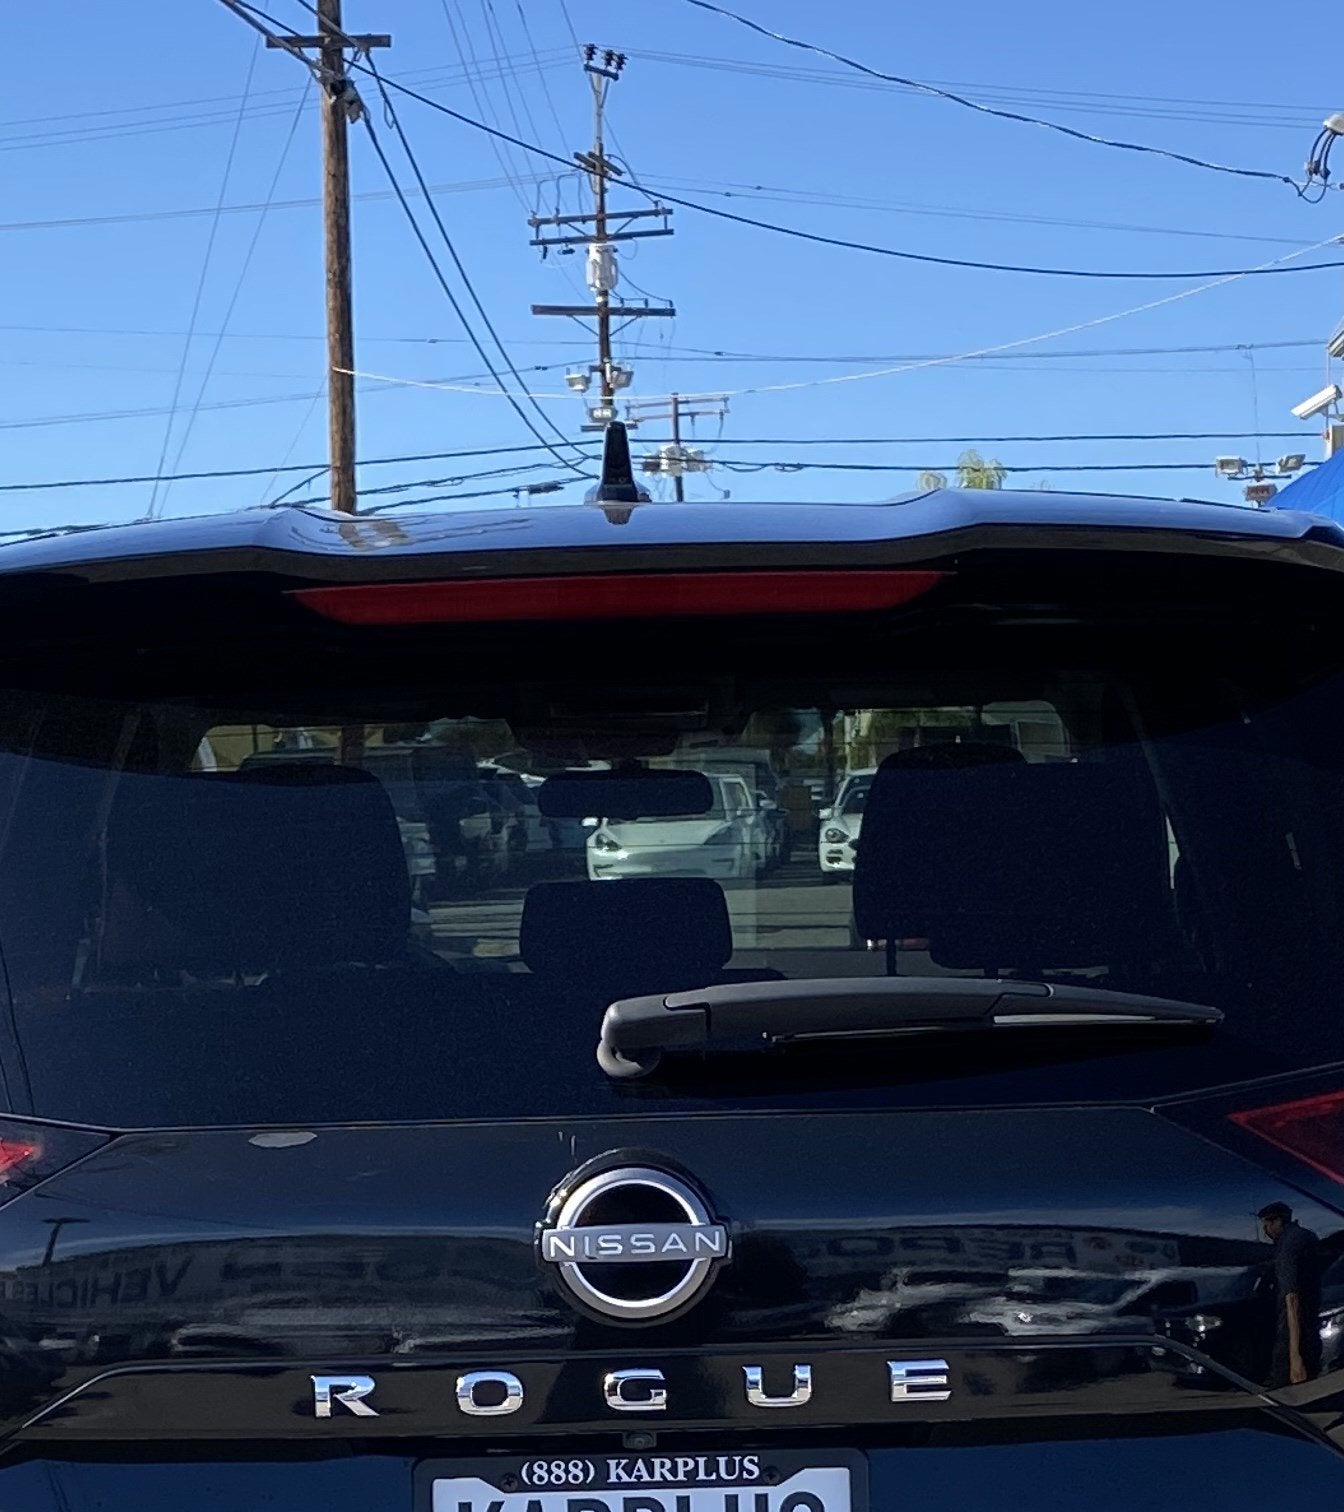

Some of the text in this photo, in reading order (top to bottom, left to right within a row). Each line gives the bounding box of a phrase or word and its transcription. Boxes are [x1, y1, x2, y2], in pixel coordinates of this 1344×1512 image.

[549, 1231, 720, 1258] NISSAN
[311, 1359, 952, 1417] ROGUE
[521, 1456, 760, 1485] (888) KARPLUS
